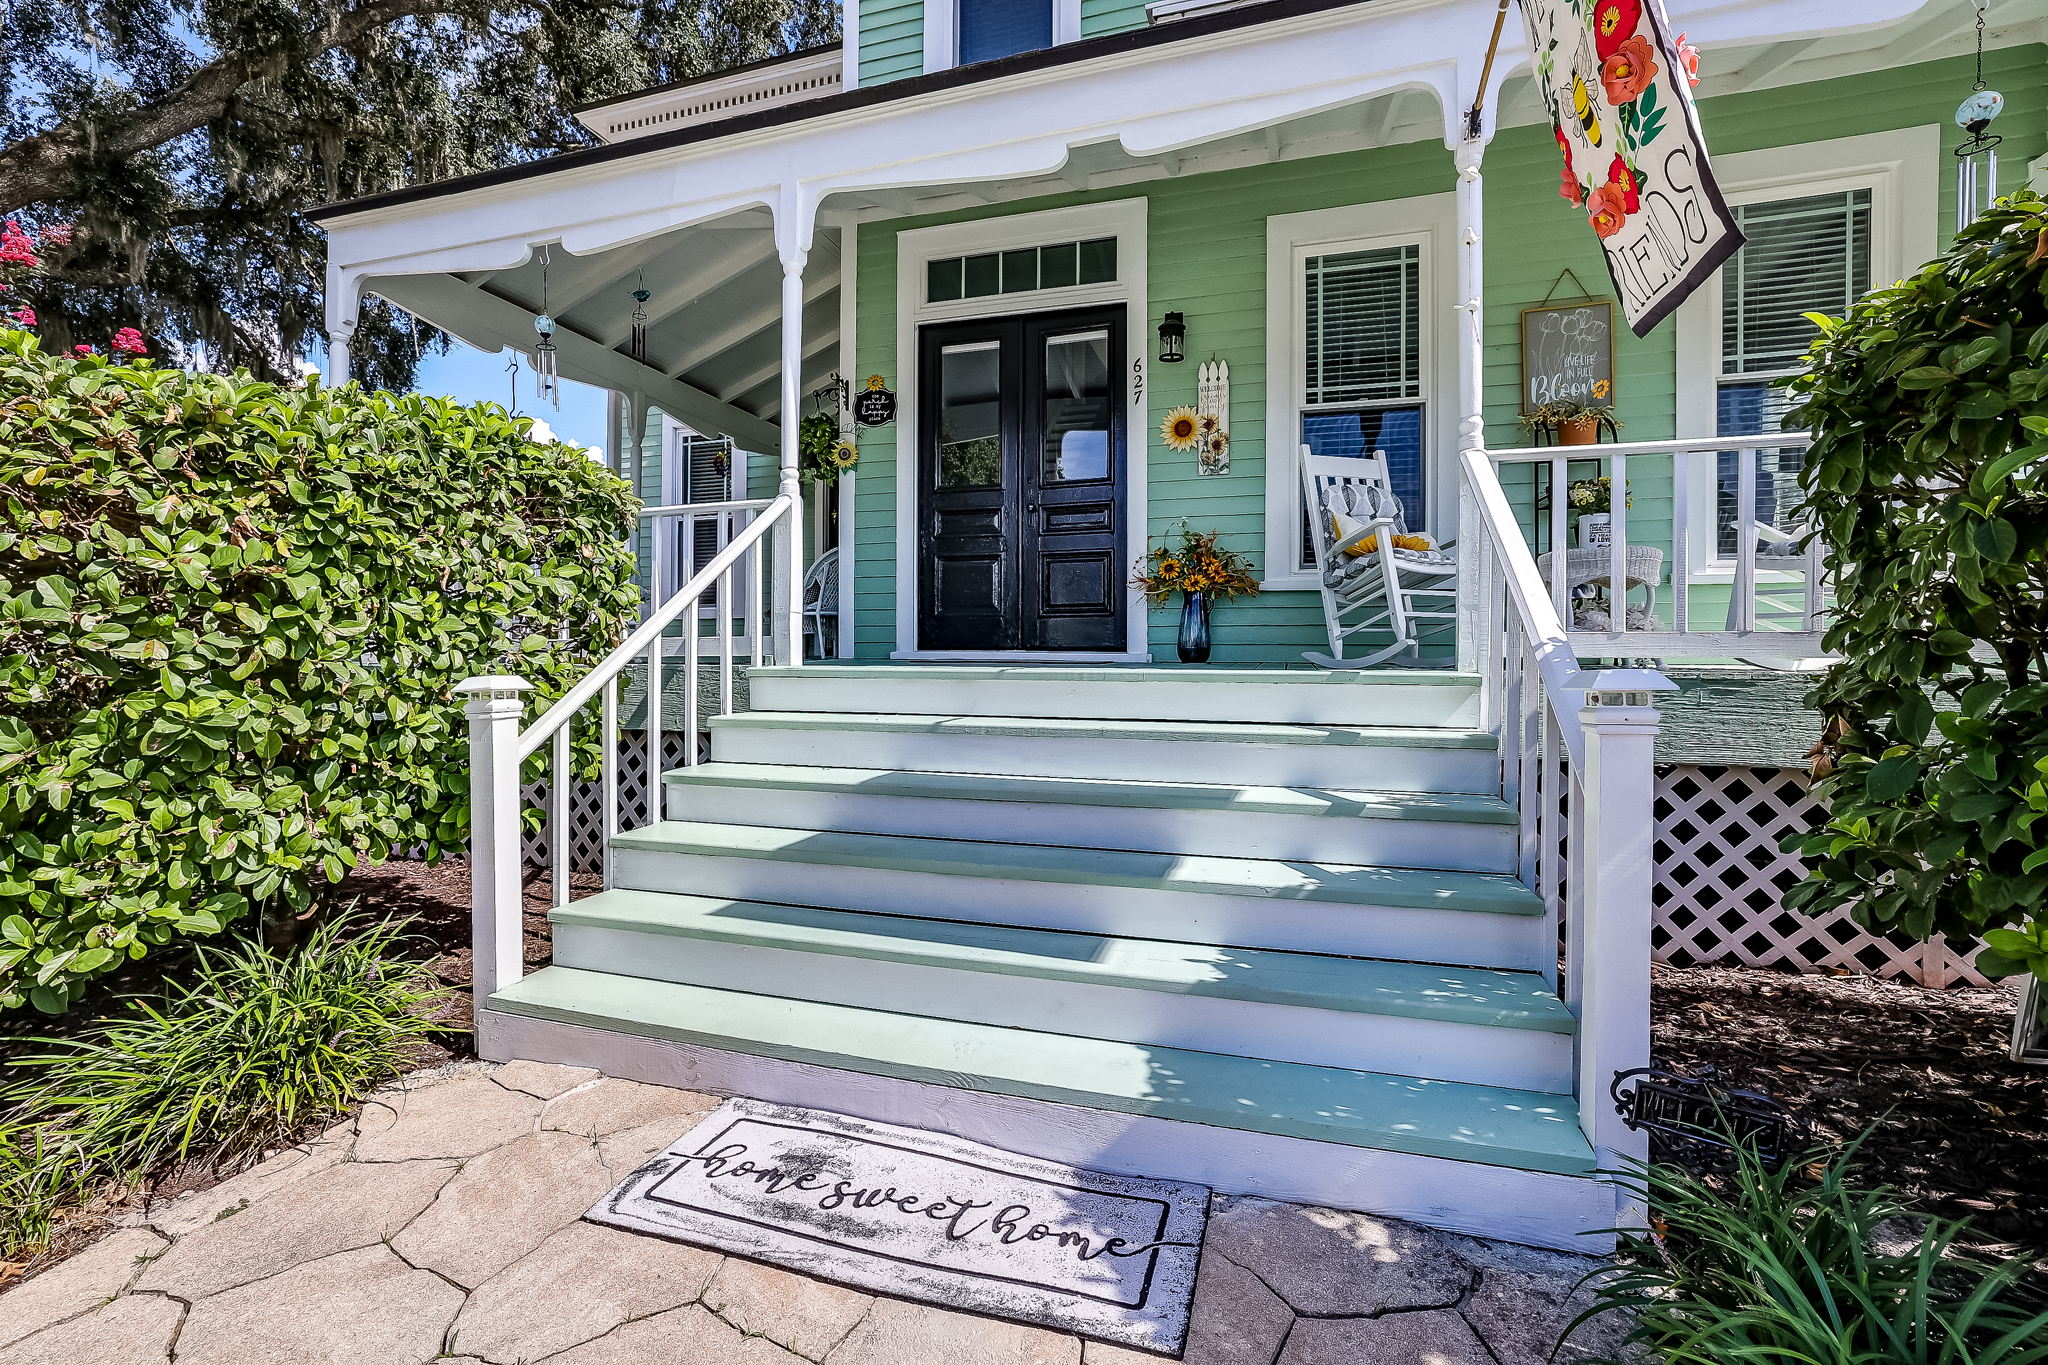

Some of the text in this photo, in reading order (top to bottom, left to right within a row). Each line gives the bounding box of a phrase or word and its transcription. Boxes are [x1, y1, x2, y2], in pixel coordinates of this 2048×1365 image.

[1565, 354, 1595, 368] LIVE LIFE
[1566, 368, 1575, 379] IN
[685, 1143, 1145, 1262] home sweet home
